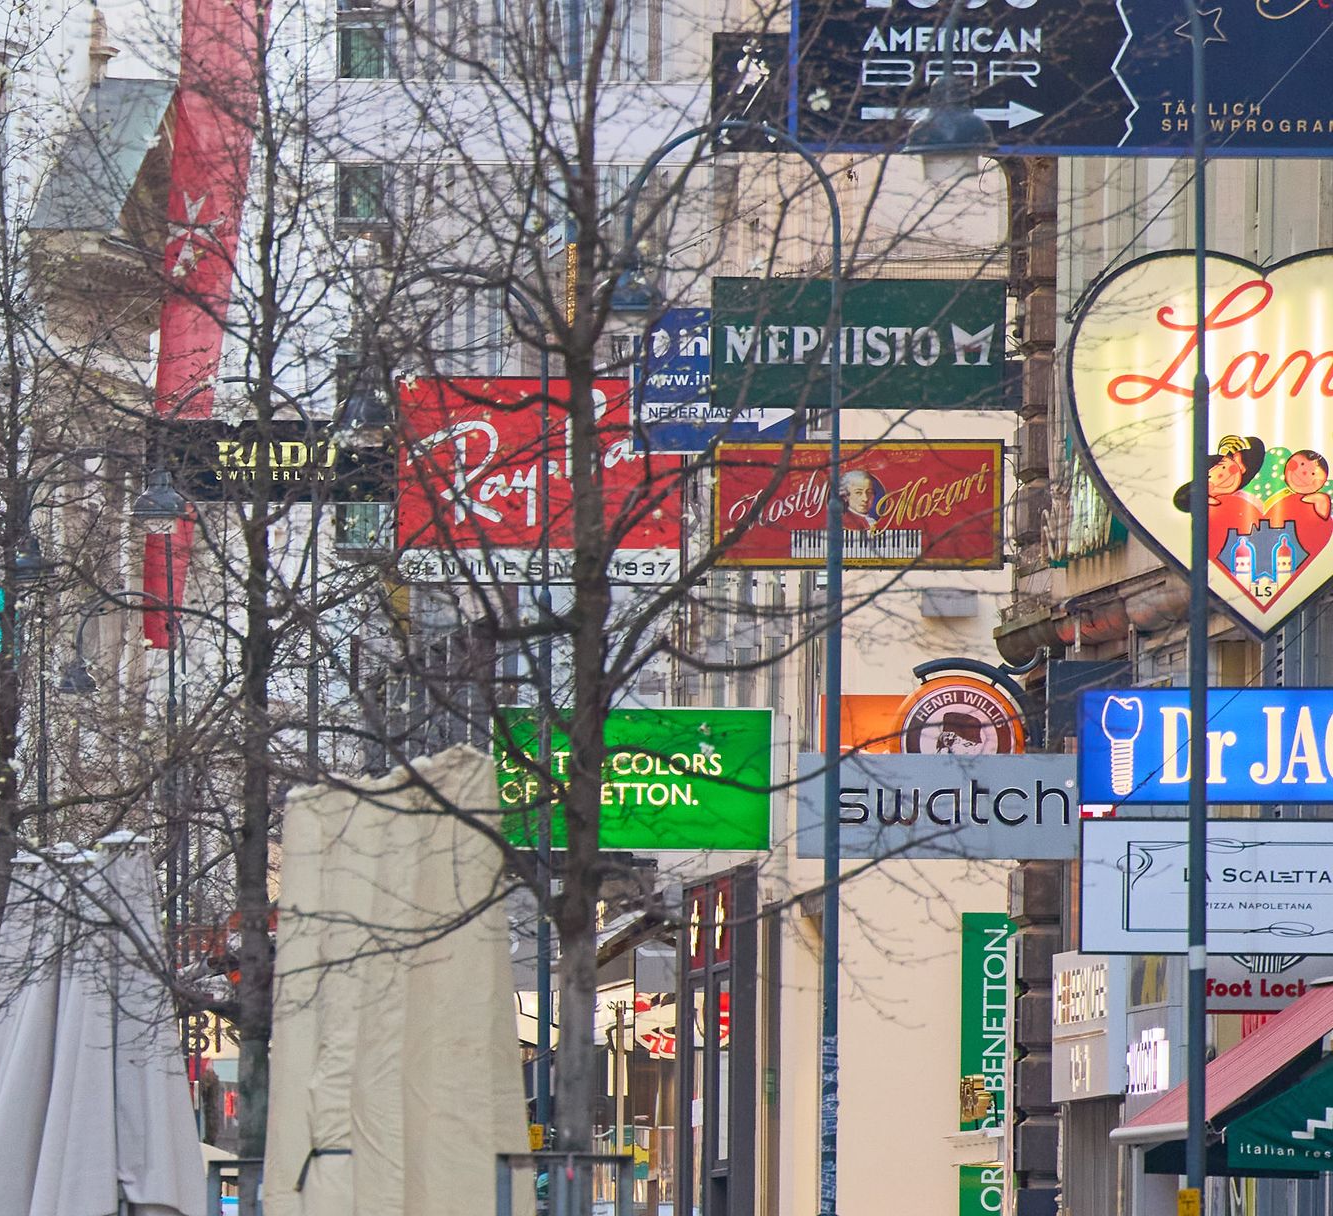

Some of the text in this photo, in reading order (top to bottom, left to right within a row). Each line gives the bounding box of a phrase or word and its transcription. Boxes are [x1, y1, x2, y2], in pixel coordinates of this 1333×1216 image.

[862, 26, 1042, 54] AMERICAN
[862, 59, 1042, 88] BAR
[873, 462, 990, 536] Mozart
[1255, 586, 1273, 597] LS
[915, 690, 1009, 730] HENRI WILLIG
[1250, 705, 1333, 786] JA
[839, 779, 1071, 827] swatch
[1239, 1142, 1295, 1158] italian
